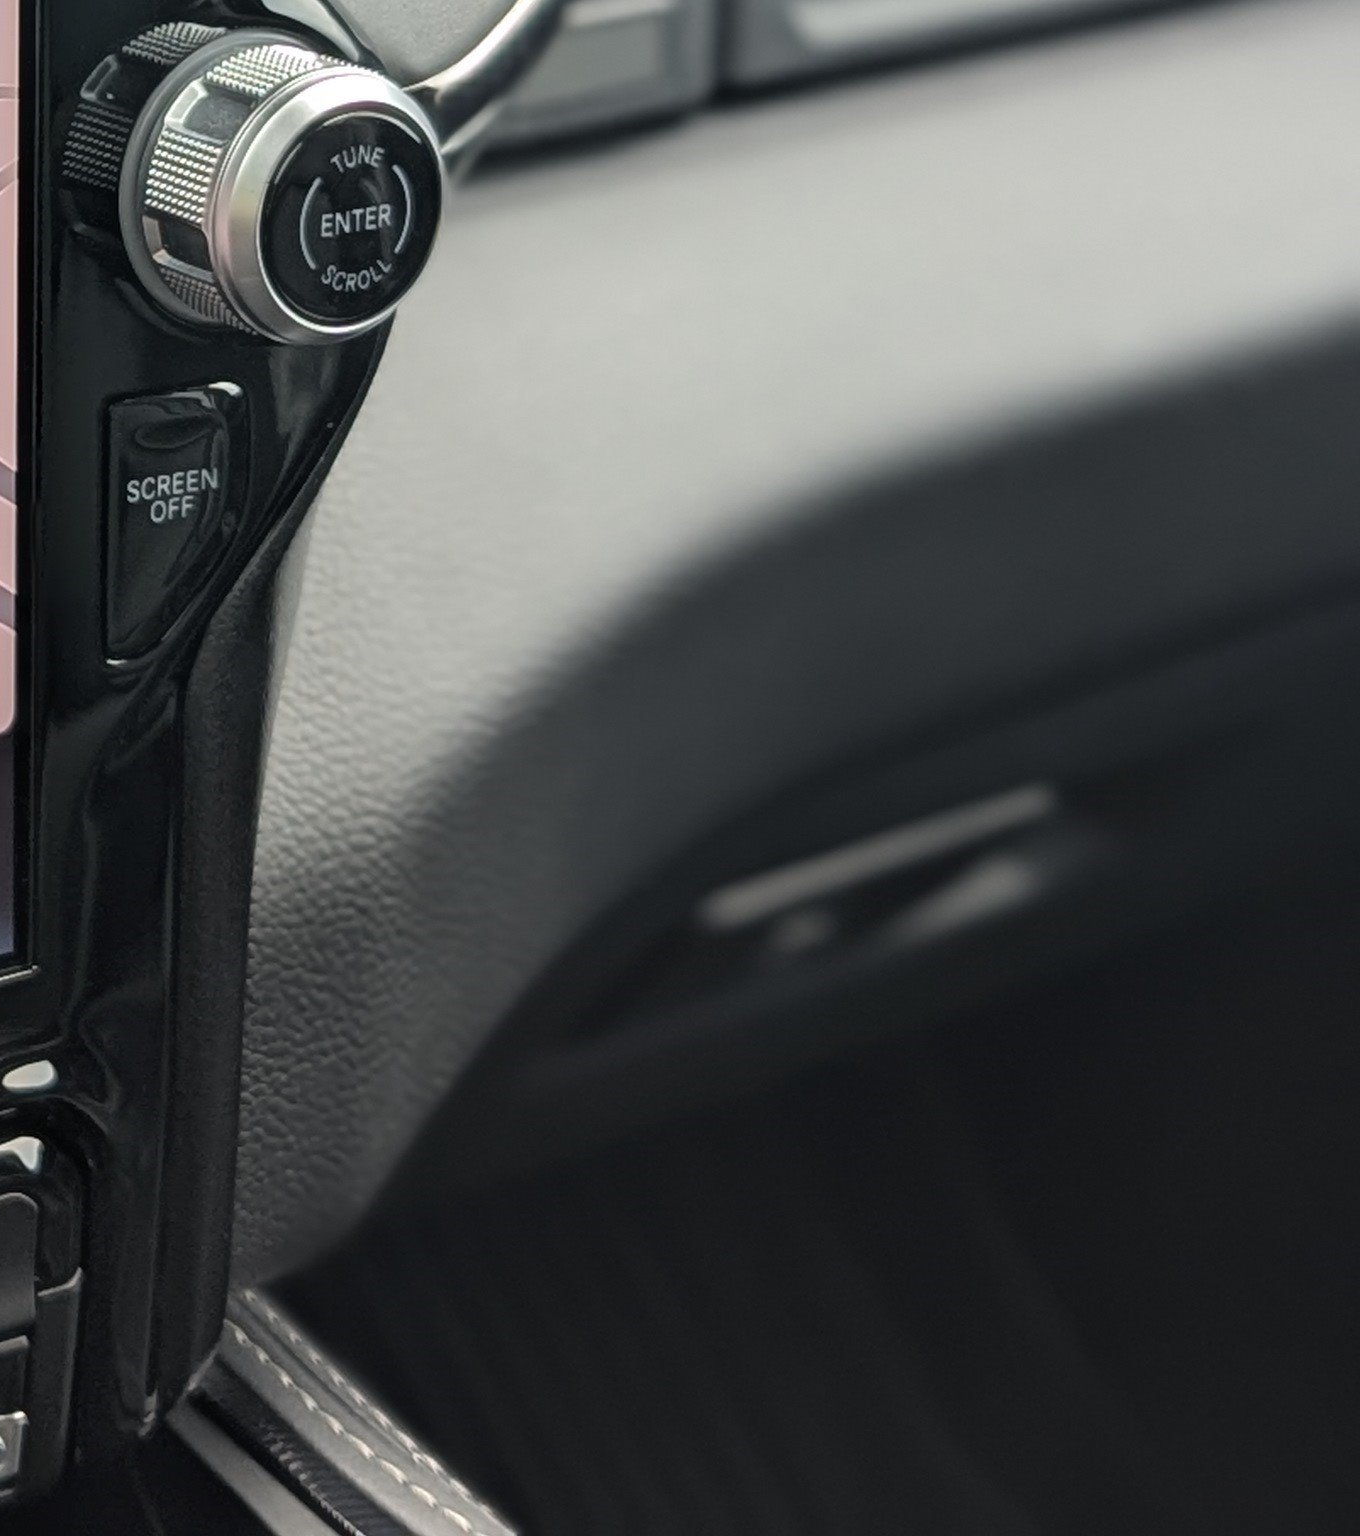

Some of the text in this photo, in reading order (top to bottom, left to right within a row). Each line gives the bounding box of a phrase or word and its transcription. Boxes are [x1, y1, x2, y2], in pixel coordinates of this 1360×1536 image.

[330, 146, 385, 172] TUNE
[320, 204, 392, 237] ENTER
[321, 259, 392, 293] SCROLL
[126, 468, 219, 504] SCREEN
[150, 495, 195, 524] OFF
